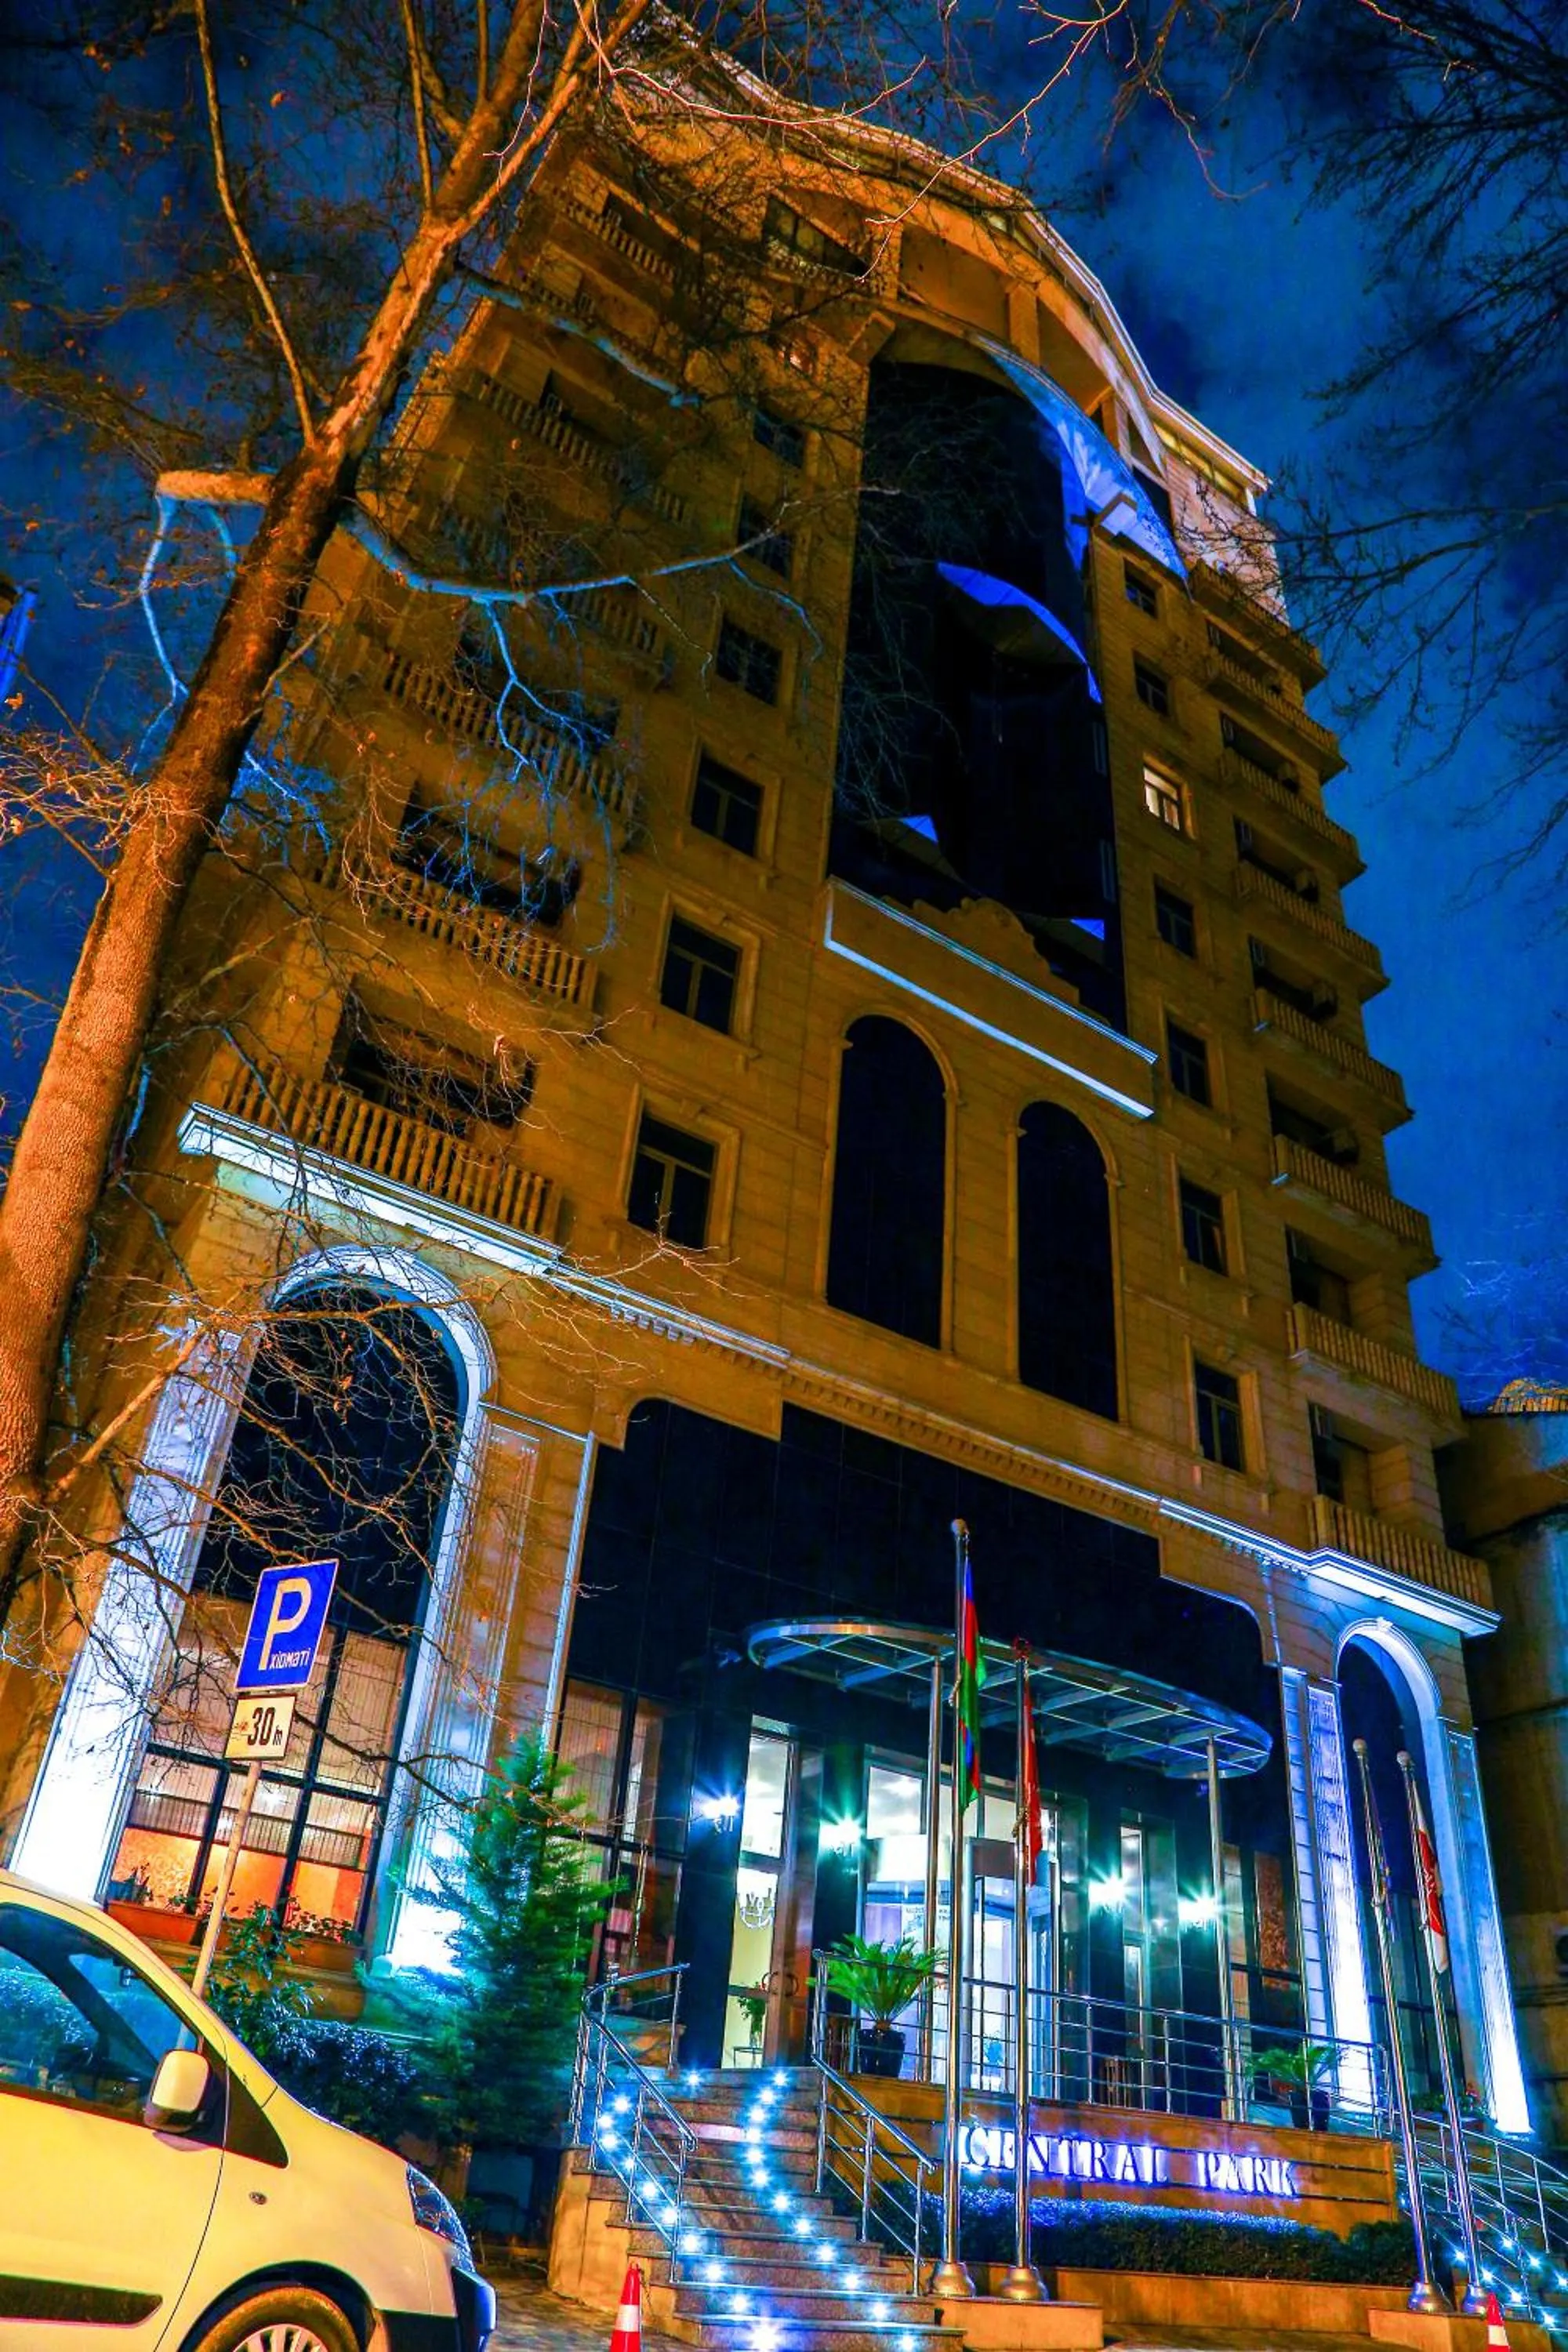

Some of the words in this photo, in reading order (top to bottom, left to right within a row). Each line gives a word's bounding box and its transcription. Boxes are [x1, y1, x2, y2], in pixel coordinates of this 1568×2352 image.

[258, 1577, 311, 1670] P
[247, 1707, 276, 1745] 30
[962, 2125, 1168, 2185] CENTRAL
[1203, 2151, 1299, 2197] PARK
